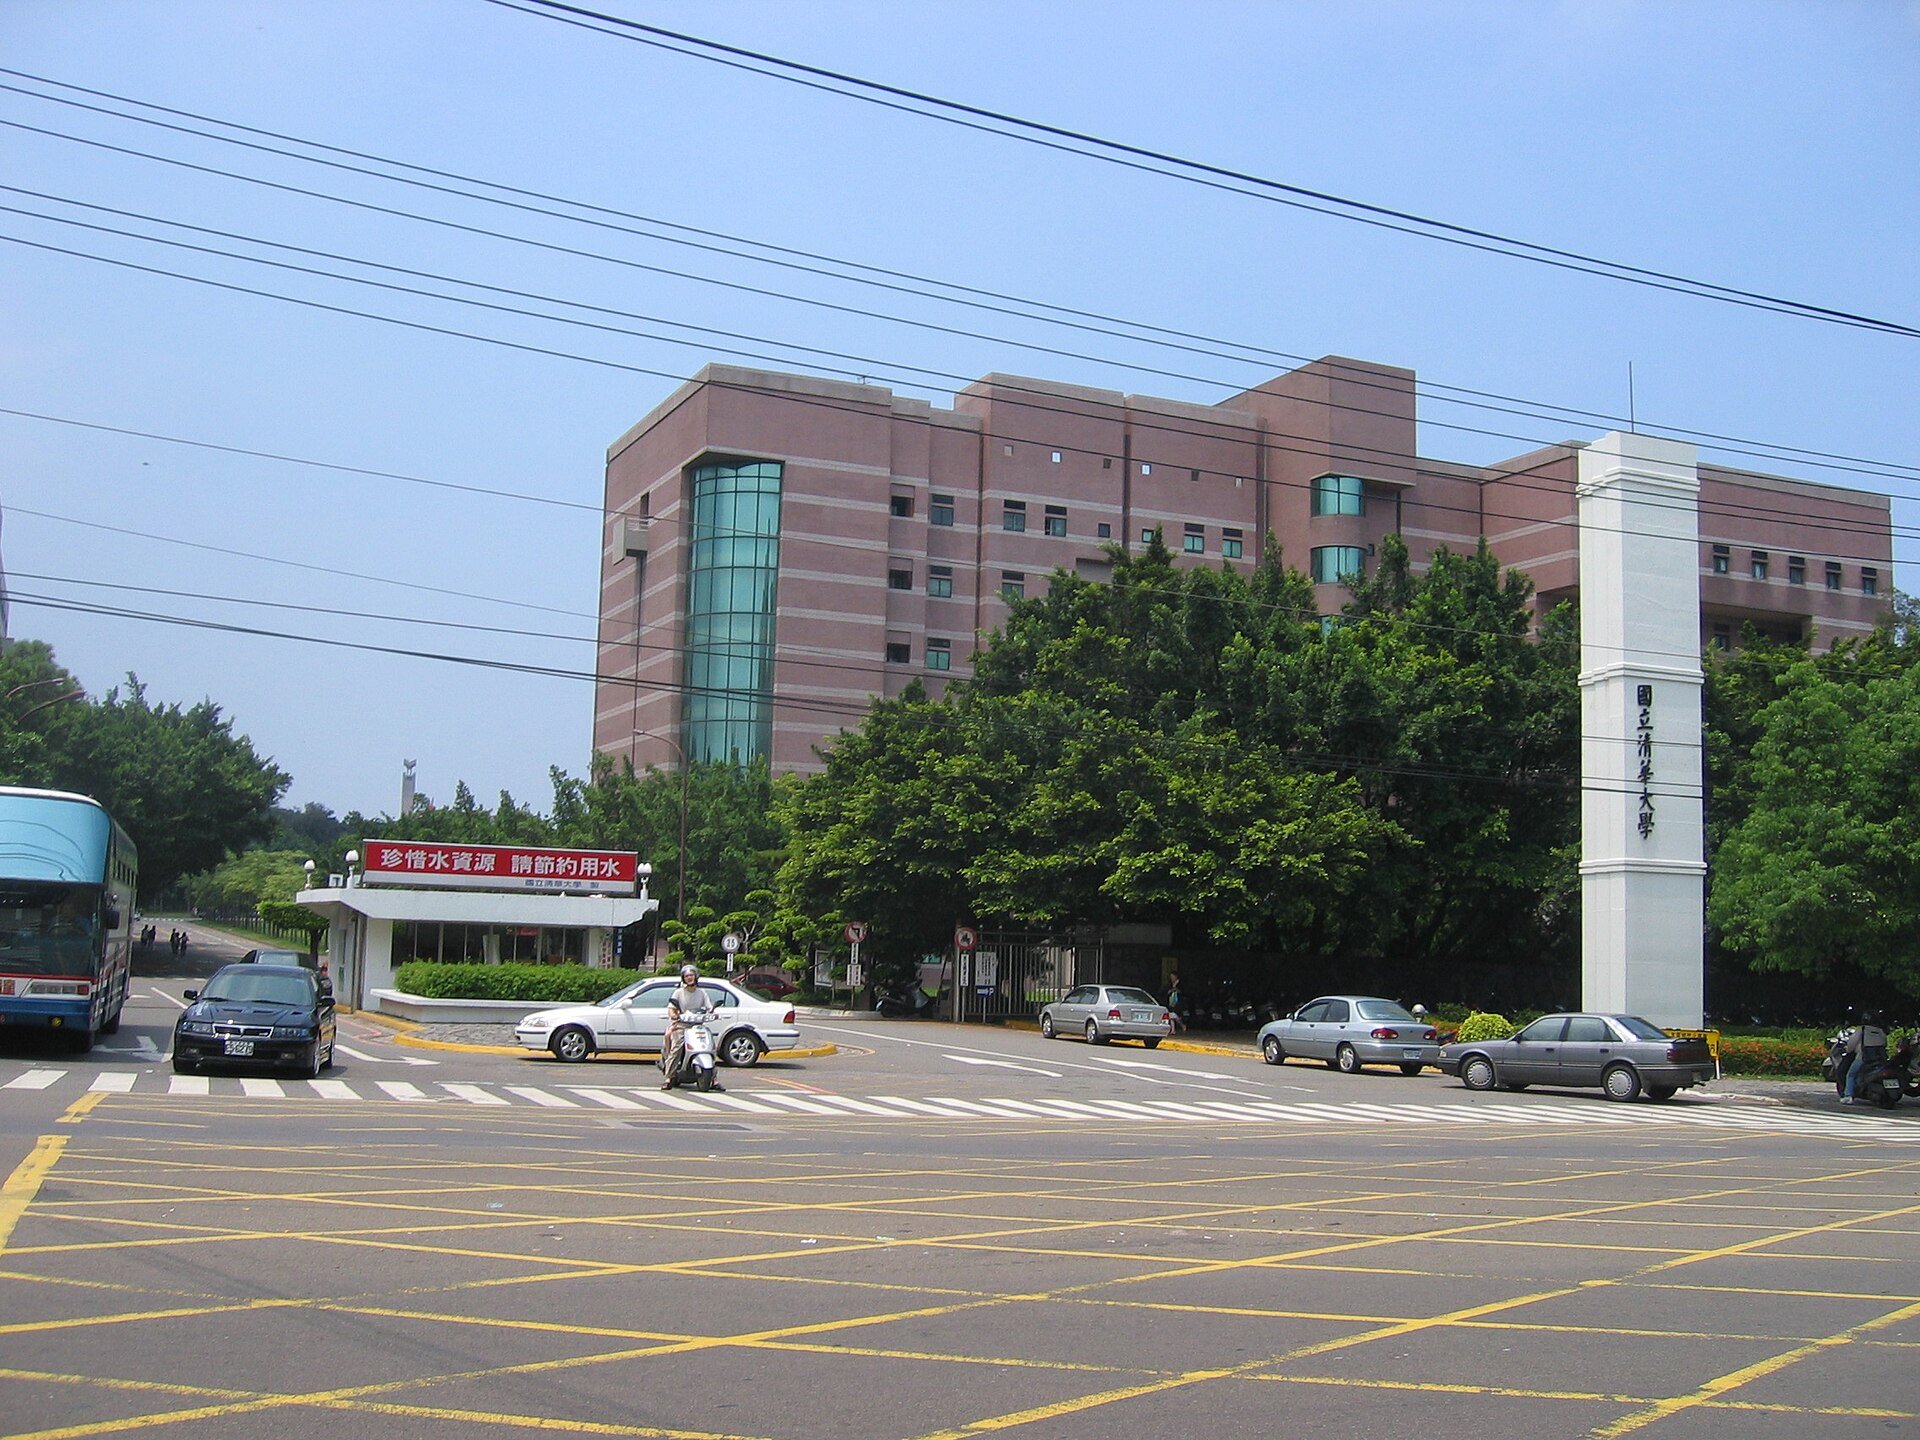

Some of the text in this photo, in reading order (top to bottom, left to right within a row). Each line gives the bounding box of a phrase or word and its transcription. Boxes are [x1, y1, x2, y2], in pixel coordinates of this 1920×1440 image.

[1637, 684, 1655, 840] 國立清華大學
[380, 848, 621, 877] 珍惜水資源 請節約用水
